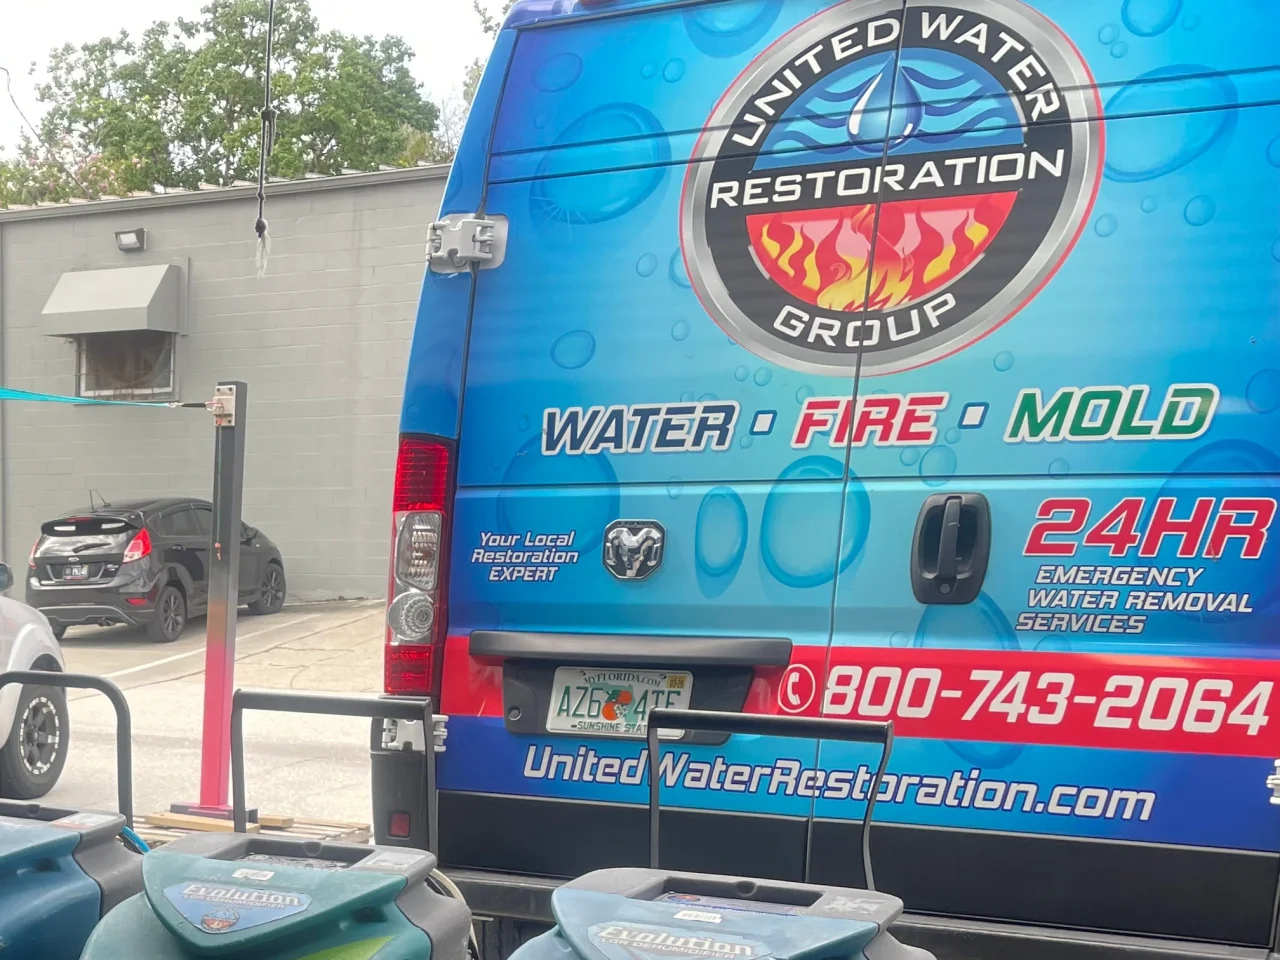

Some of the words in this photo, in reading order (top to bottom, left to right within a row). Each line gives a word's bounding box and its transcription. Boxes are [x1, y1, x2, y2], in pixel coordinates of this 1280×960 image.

[732, 17, 901, 147] UNITED
[921, 11, 1060, 122] WATER
[709, 149, 1065, 209] RESTORATION
[772, 292, 957, 348] GROUP
[542, 400, 740, 456] WATER
[790, 392, 949, 449] FIRE
[1003, 383, 1220, 444] MOLD
[479, 531, 521, 547] Your
[524, 531, 576, 547] Local
[1023, 496, 1278, 560] 24HR
[471, 548, 579, 564] Restoration
[488, 566, 559, 582] EXPERT
[1034, 566, 1205, 588] EMERGENCY
[1027, 589, 1120, 610] WATER
[1123, 591, 1253, 613] REMOVAL
[1015, 613, 1148, 634] SERVICES
[823, 665, 1275, 736] 800-743-2064
[577, 721, 620, 732] SUNSHINE
[624, 723, 648, 734] STAT
[522, 743, 1157, 822] UnitedWaterRestoration.com
[181, 883, 300, 907] Evolution
[597, 926, 755, 957] Evolution
[600, 937, 631, 947] LGR
[632, 940, 736, 960] DEHUMIDIFIER
